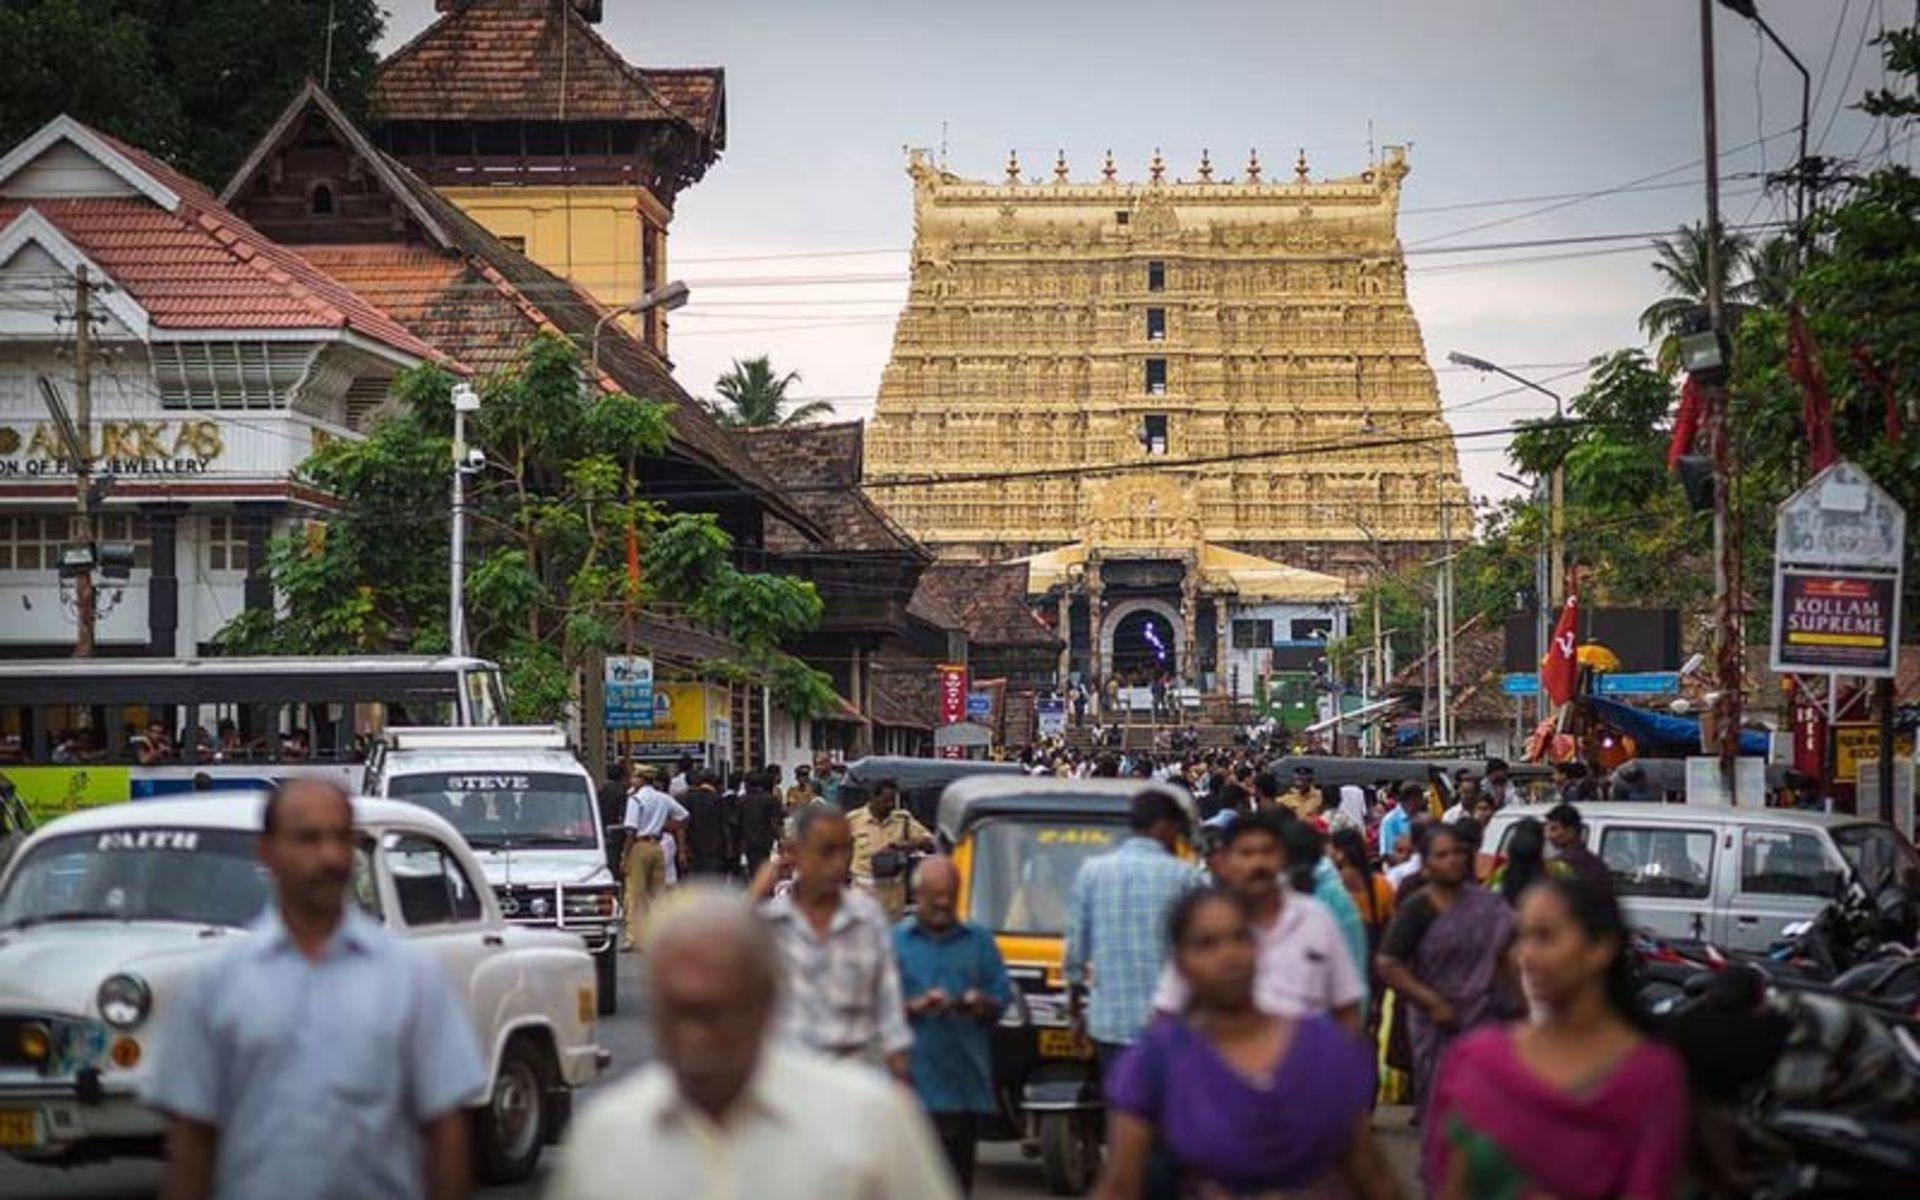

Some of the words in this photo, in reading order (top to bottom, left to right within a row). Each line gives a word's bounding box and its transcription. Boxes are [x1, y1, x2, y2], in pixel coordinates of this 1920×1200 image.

[26, 460, 48, 474] OF
[101, 459, 211, 474] JEWELLERY
[1794, 597, 1880, 616] KOLLAM
[1787, 613, 1885, 634] SUPREME
[447, 776, 530, 790] STEVE
[98, 832, 199, 850] FAITH
